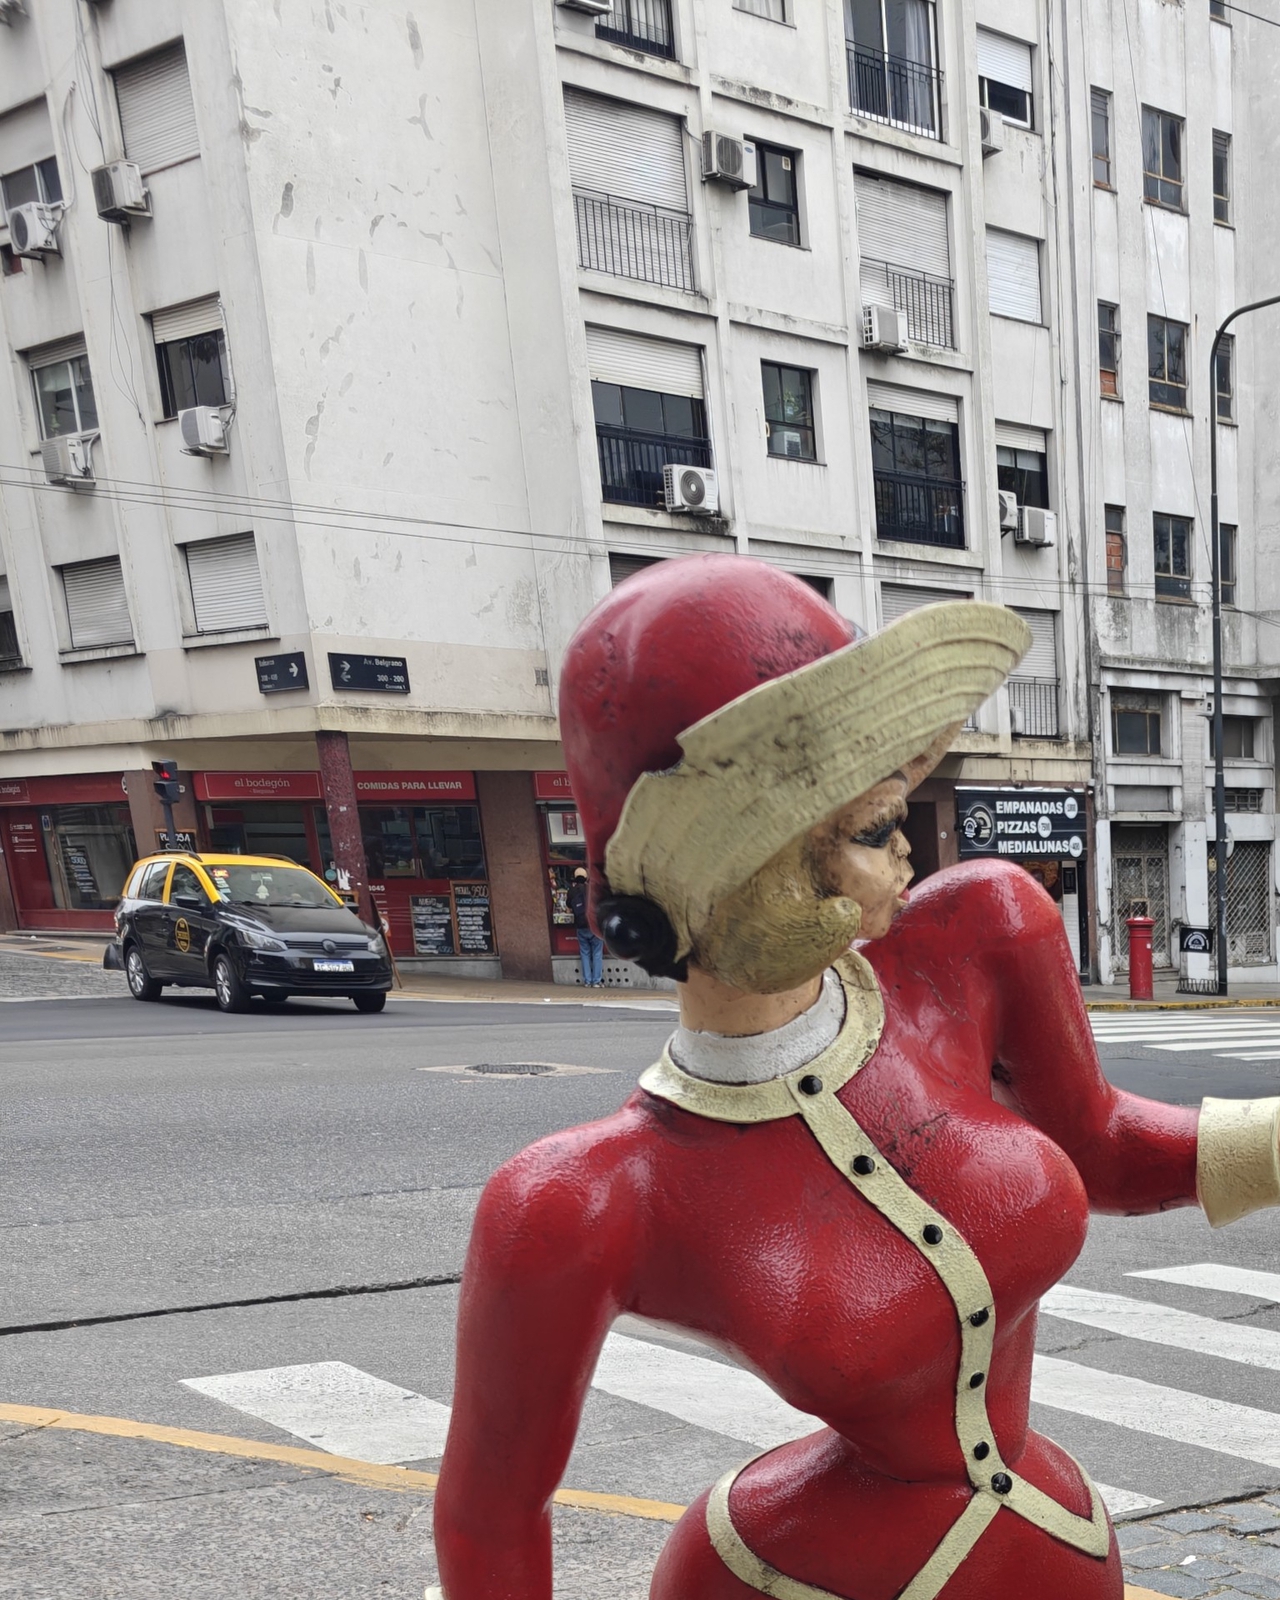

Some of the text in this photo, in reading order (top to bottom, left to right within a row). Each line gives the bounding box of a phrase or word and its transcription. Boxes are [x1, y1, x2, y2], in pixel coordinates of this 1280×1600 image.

[374, 658, 403, 668] Belgrano
[234, 777, 290, 790] el bodegón
[357, 781, 462, 791] COMIDAS PARA LLEVAR
[995, 801, 1064, 815] EMPANADAS
[997, 821, 1037, 834] PIZZAS
[998, 840, 1069, 854] MEDIALUNAS
